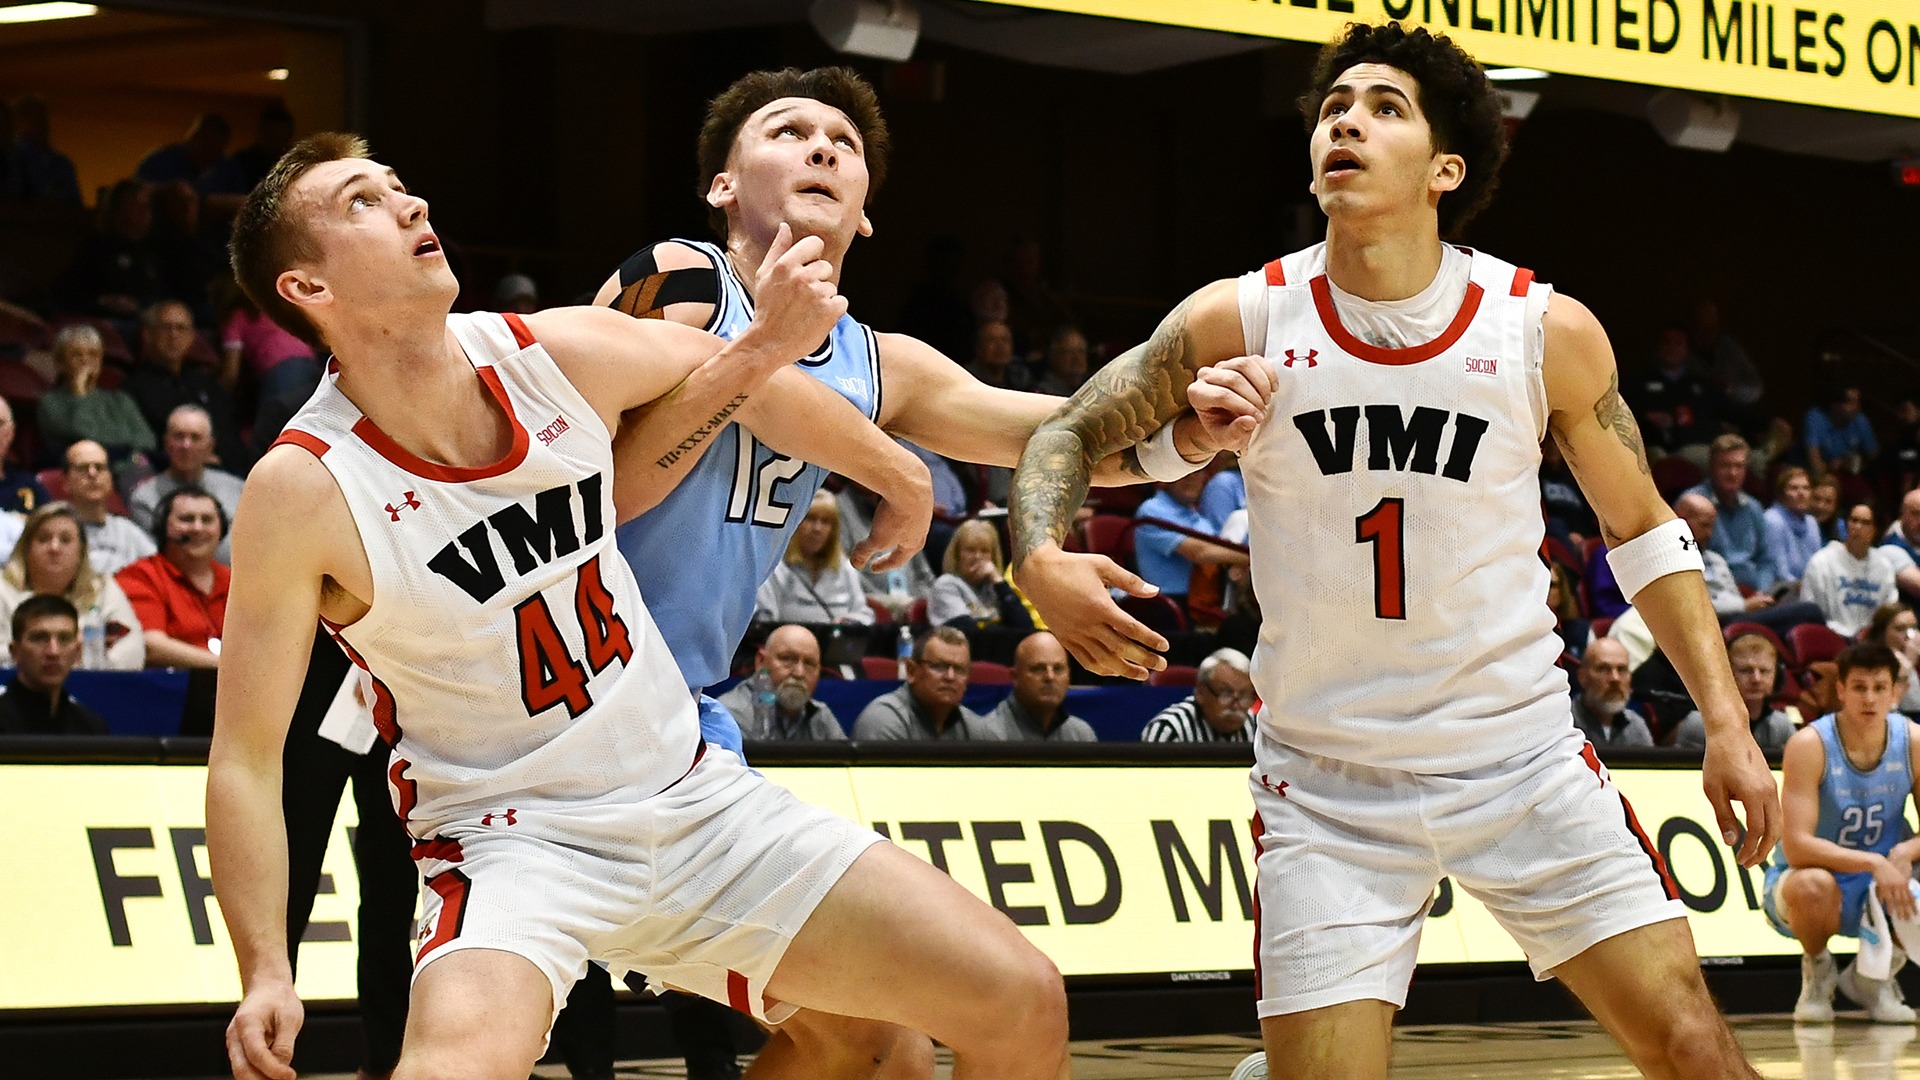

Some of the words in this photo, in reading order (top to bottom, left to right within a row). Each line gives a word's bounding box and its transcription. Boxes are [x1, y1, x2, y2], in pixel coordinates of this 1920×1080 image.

[1703, 0, 1846, 77] MILES
[1465, 356, 1497, 375] SOCON
[536, 414, 570, 447] SOCON
[1293, 404, 1490, 483] VMI
[725, 421, 808, 529] 12
[427, 472, 604, 604] VMI
[1355, 497, 1406, 620] 1
[513, 552, 635, 720] 44
[1838, 804, 1884, 847] 25
